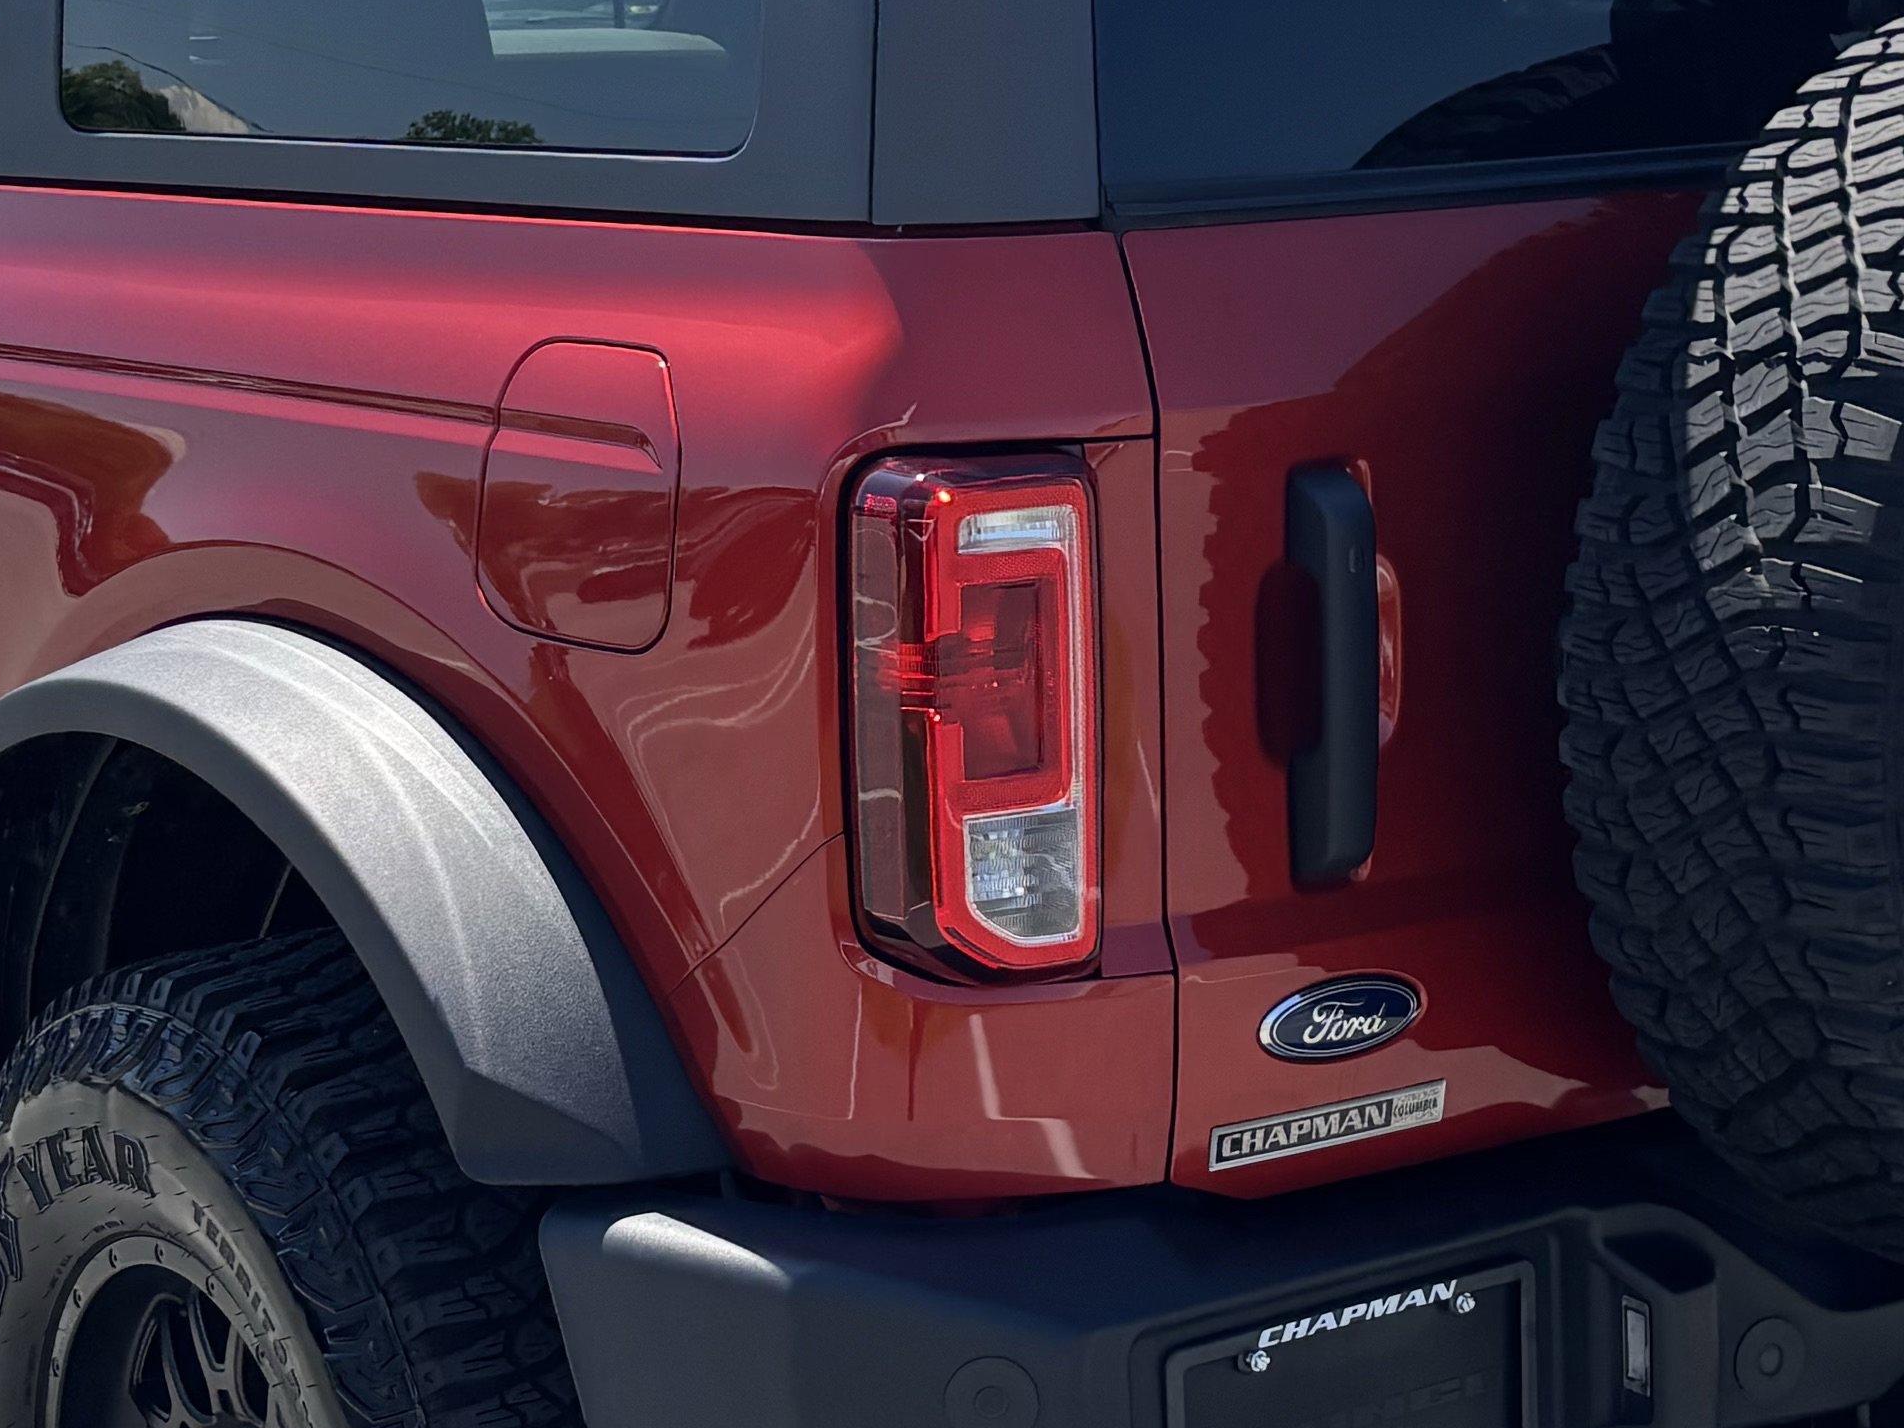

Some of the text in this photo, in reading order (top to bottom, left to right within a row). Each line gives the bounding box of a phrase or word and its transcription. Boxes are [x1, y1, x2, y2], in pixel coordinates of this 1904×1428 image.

[1302, 999, 1387, 1045] Ford
[1221, 1098, 1439, 1158] CHAPMAN COLUMBIA
[1257, 1278, 1458, 1349] CHAPMAN
